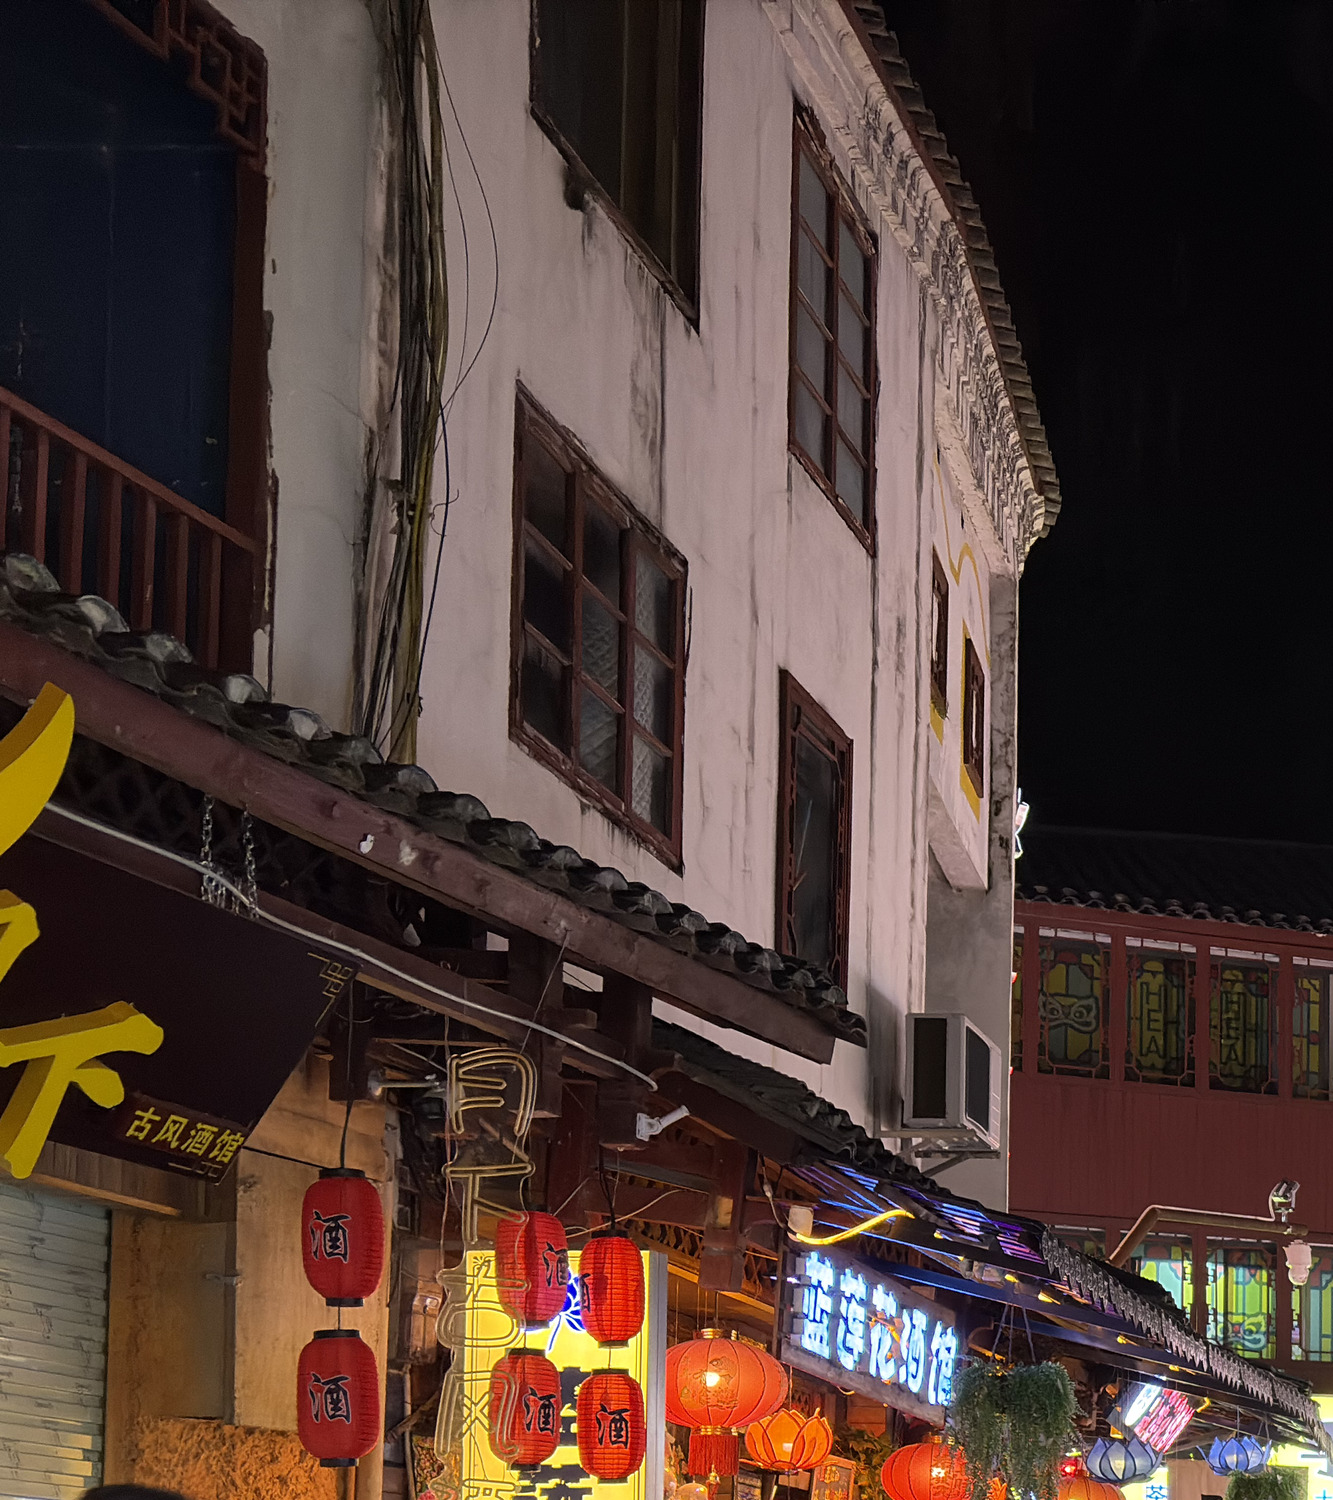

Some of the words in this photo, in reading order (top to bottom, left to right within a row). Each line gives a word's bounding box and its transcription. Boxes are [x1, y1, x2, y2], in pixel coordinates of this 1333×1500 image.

[127, 1107, 245, 1164] 古风酒馆
[309, 1210, 352, 1264] 酒
[801, 1251, 958, 1407] 蓝莲花酒馆
[309, 1370, 353, 1425] 酒
[523, 1386, 557, 1436] 酒
[595, 1403, 630, 1450] 酒
